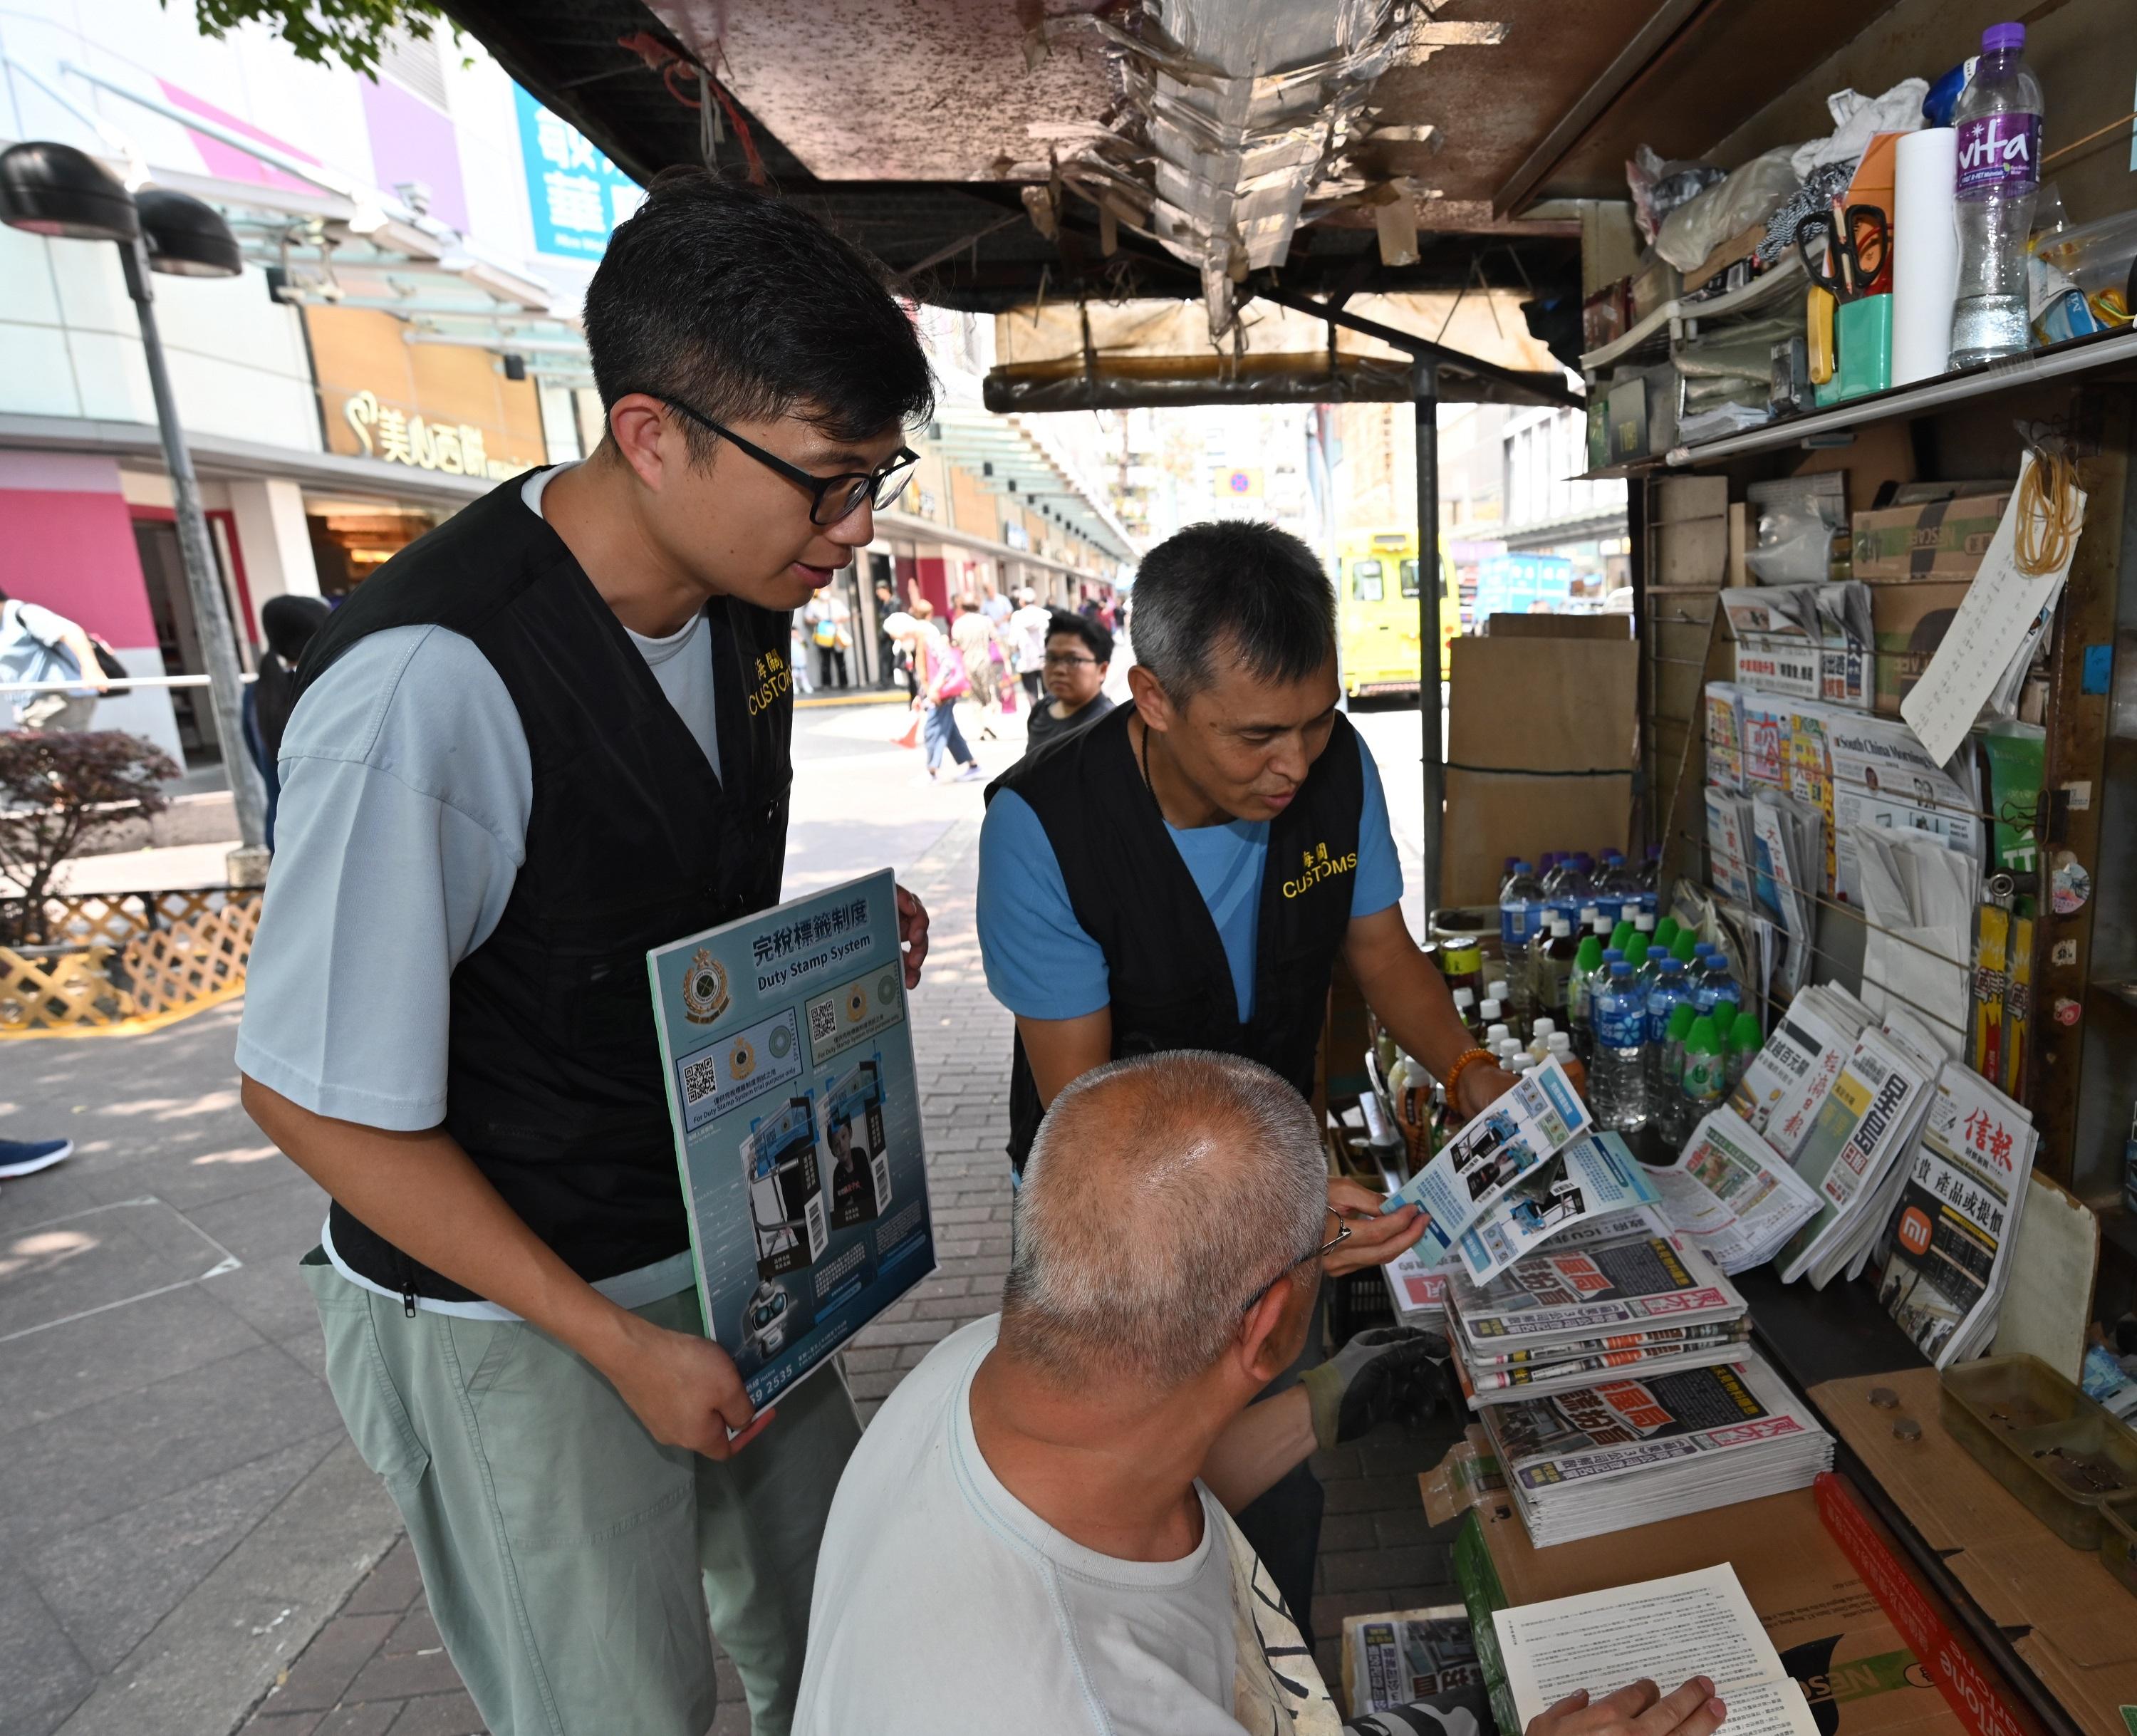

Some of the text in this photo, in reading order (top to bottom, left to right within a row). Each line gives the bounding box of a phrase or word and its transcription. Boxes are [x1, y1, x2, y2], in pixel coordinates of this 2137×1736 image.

[1959, 119, 2029, 170] vita
[1283, 853, 1357, 898] CUSTOMS
[752, 898, 868, 967] 完稅標籤制度
[757, 935, 871, 992] Duty Stamp System
[693, 1066, 796, 1124] For Duty Stamp System trial purpose only
[1964, 1106, 2013, 1173] 信報
[1934, 1170, 2005, 1237] 產品或提價
[760, 1368, 776, 1382] Hotline
[766, 1363, 793, 1394] 2535
